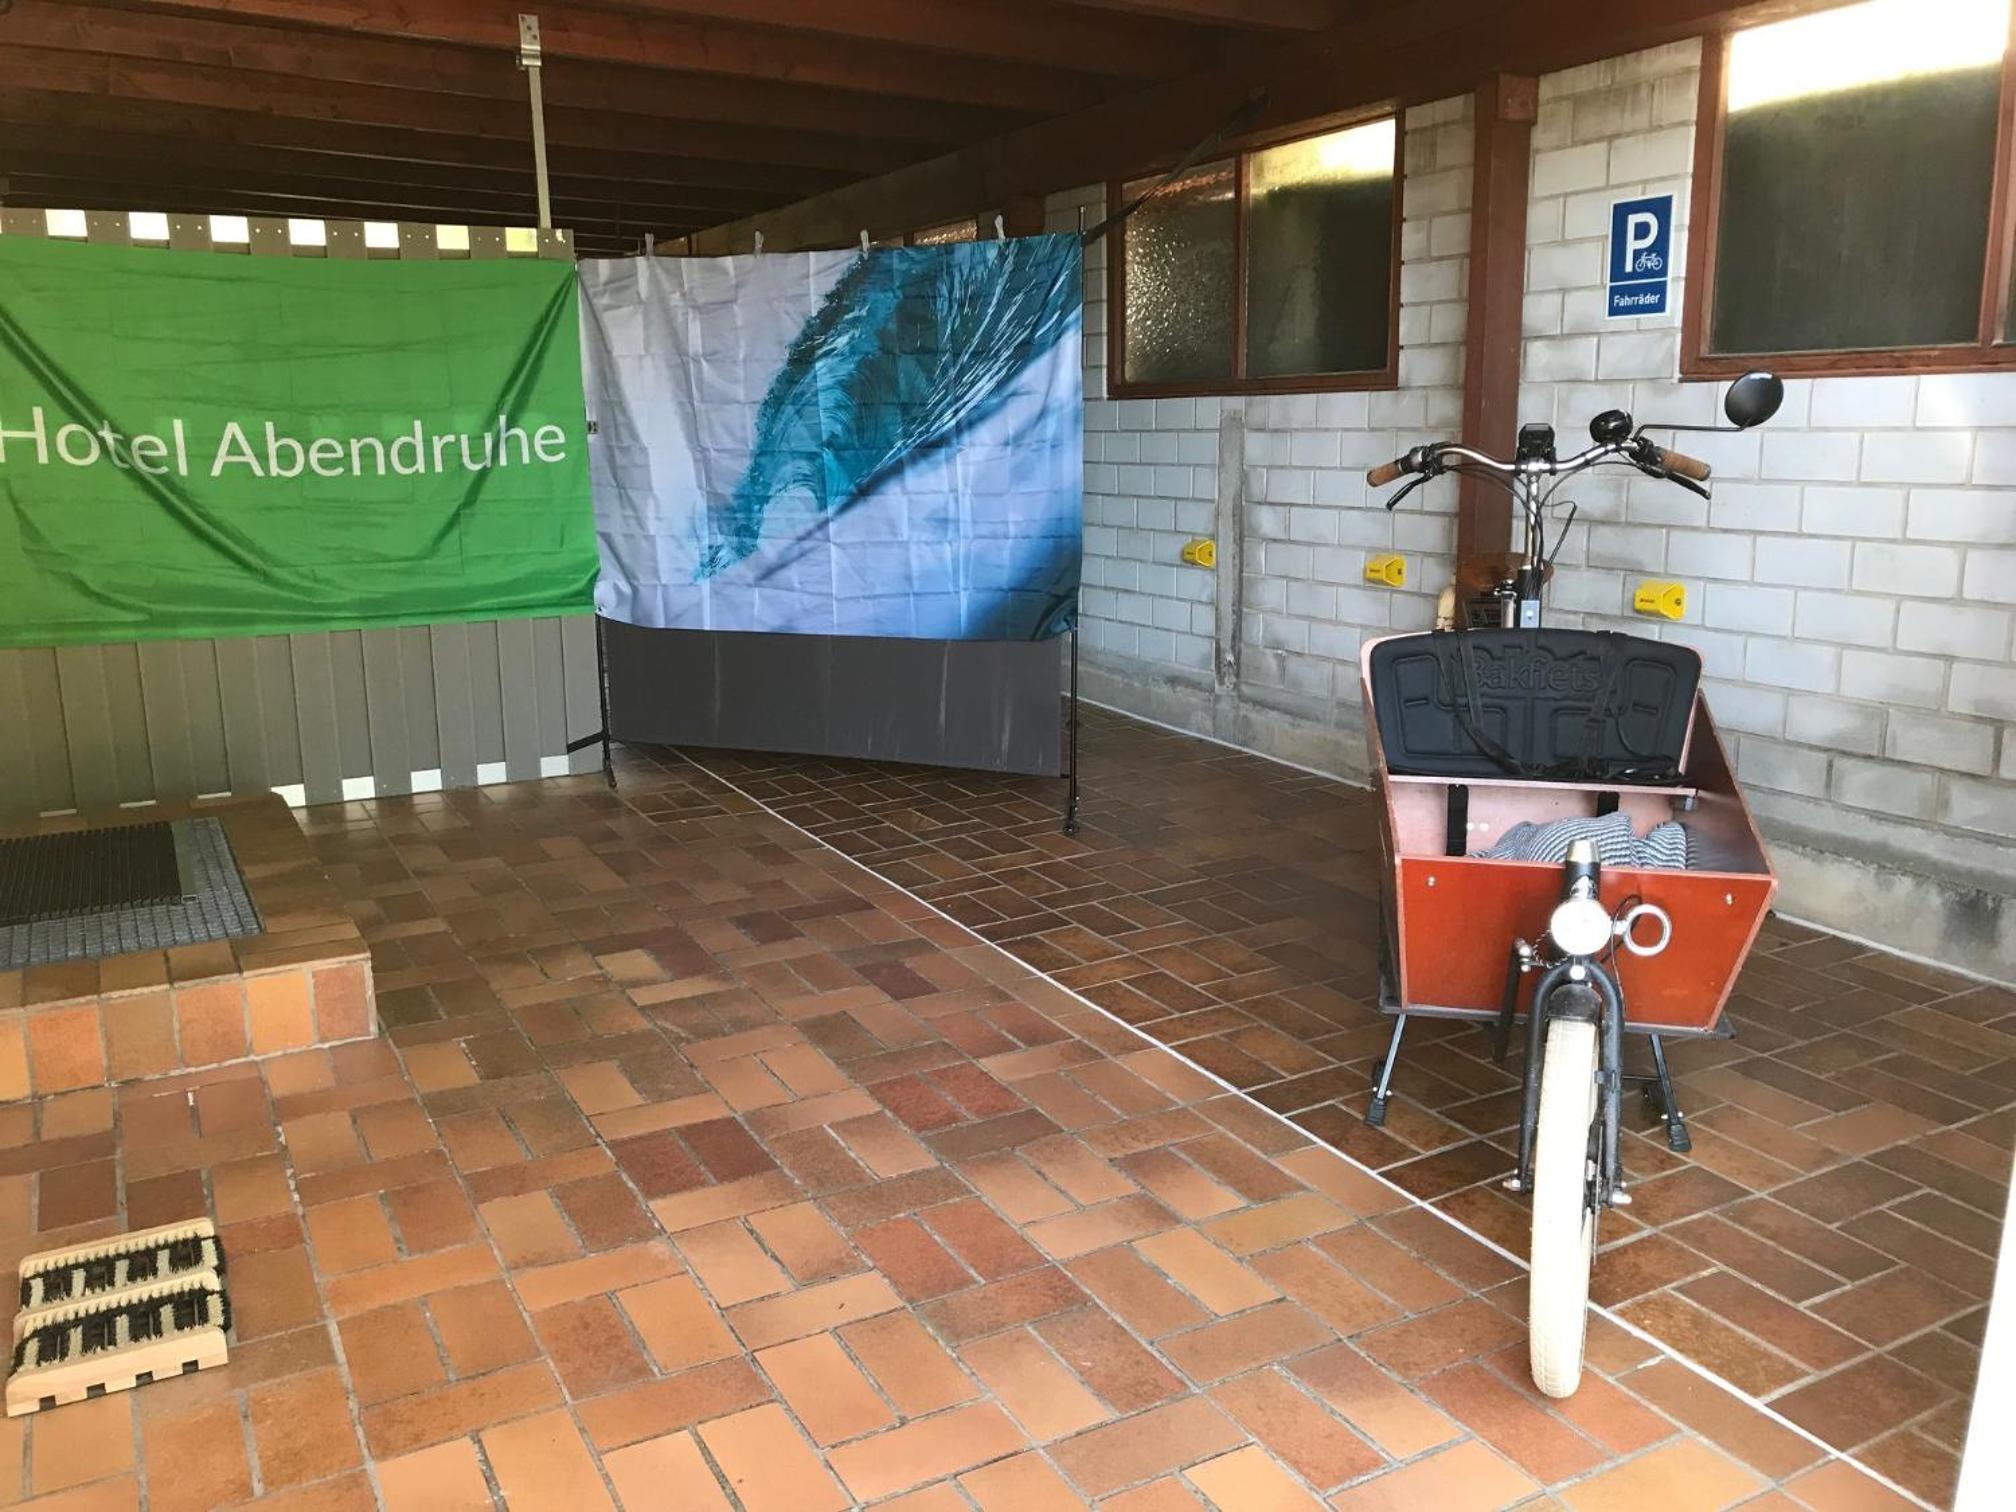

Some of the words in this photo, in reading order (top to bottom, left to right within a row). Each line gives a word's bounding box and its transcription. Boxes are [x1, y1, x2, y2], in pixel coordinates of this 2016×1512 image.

[1625, 212, 1659, 273] P
[1613, 293, 1661, 307] Fahrräder
[0, 406, 189, 476] Hotel
[210, 414, 567, 478] Abendruhe
